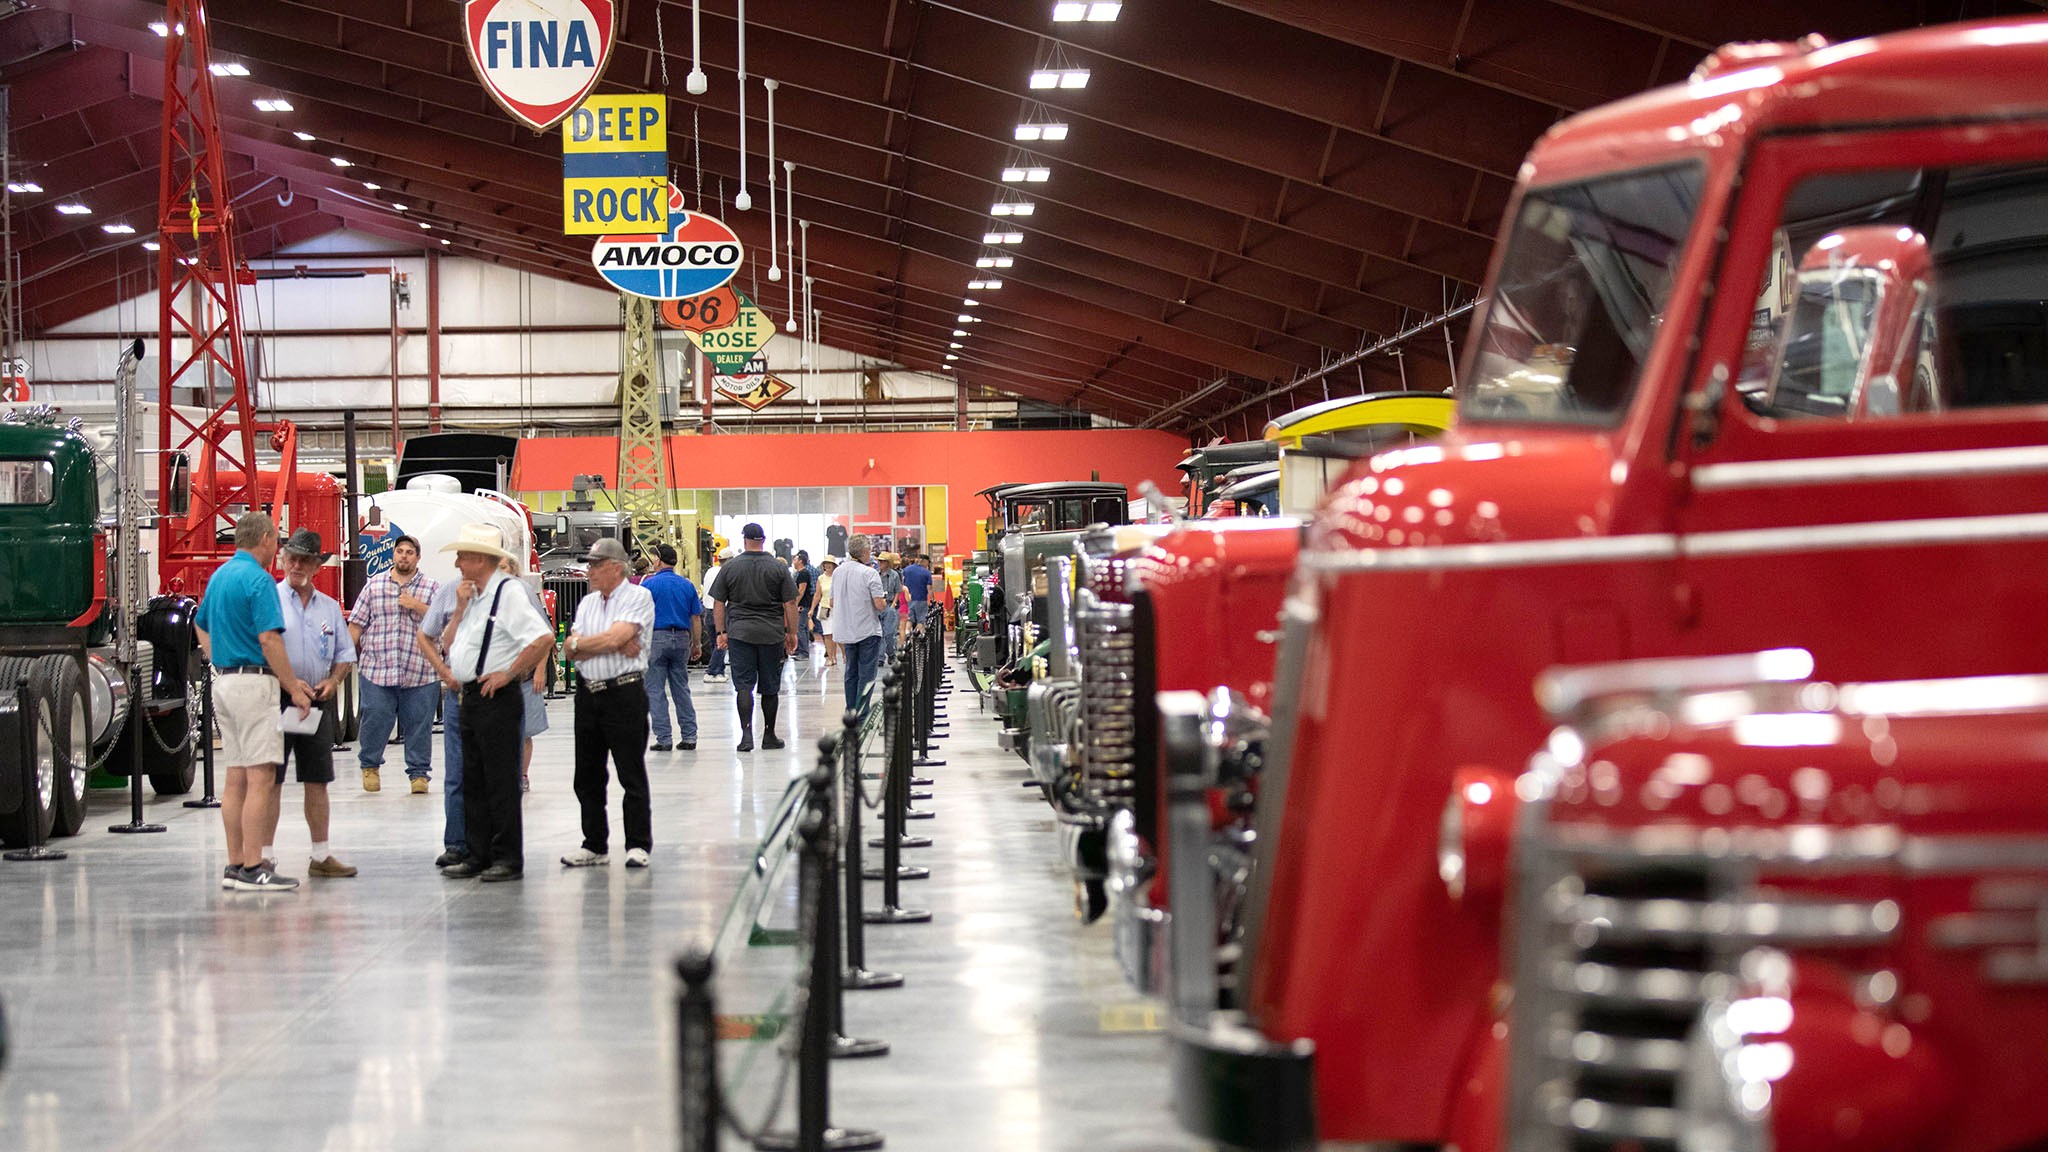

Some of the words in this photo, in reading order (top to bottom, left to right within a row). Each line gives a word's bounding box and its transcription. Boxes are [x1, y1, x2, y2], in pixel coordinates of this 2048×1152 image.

[487, 20, 595, 69] FINA
[572, 107, 659, 142] DEEP
[573, 188, 660, 223] ROCK
[598, 244, 739, 267] AMOCO
[677, 296, 721, 324] 66
[702, 332, 757, 348] ROSE
[716, 355, 744, 364] DEALER
[721, 377, 744, 392] MOTOR
[745, 377, 761, 390] OILS
[366, 555, 393, 577] Char
